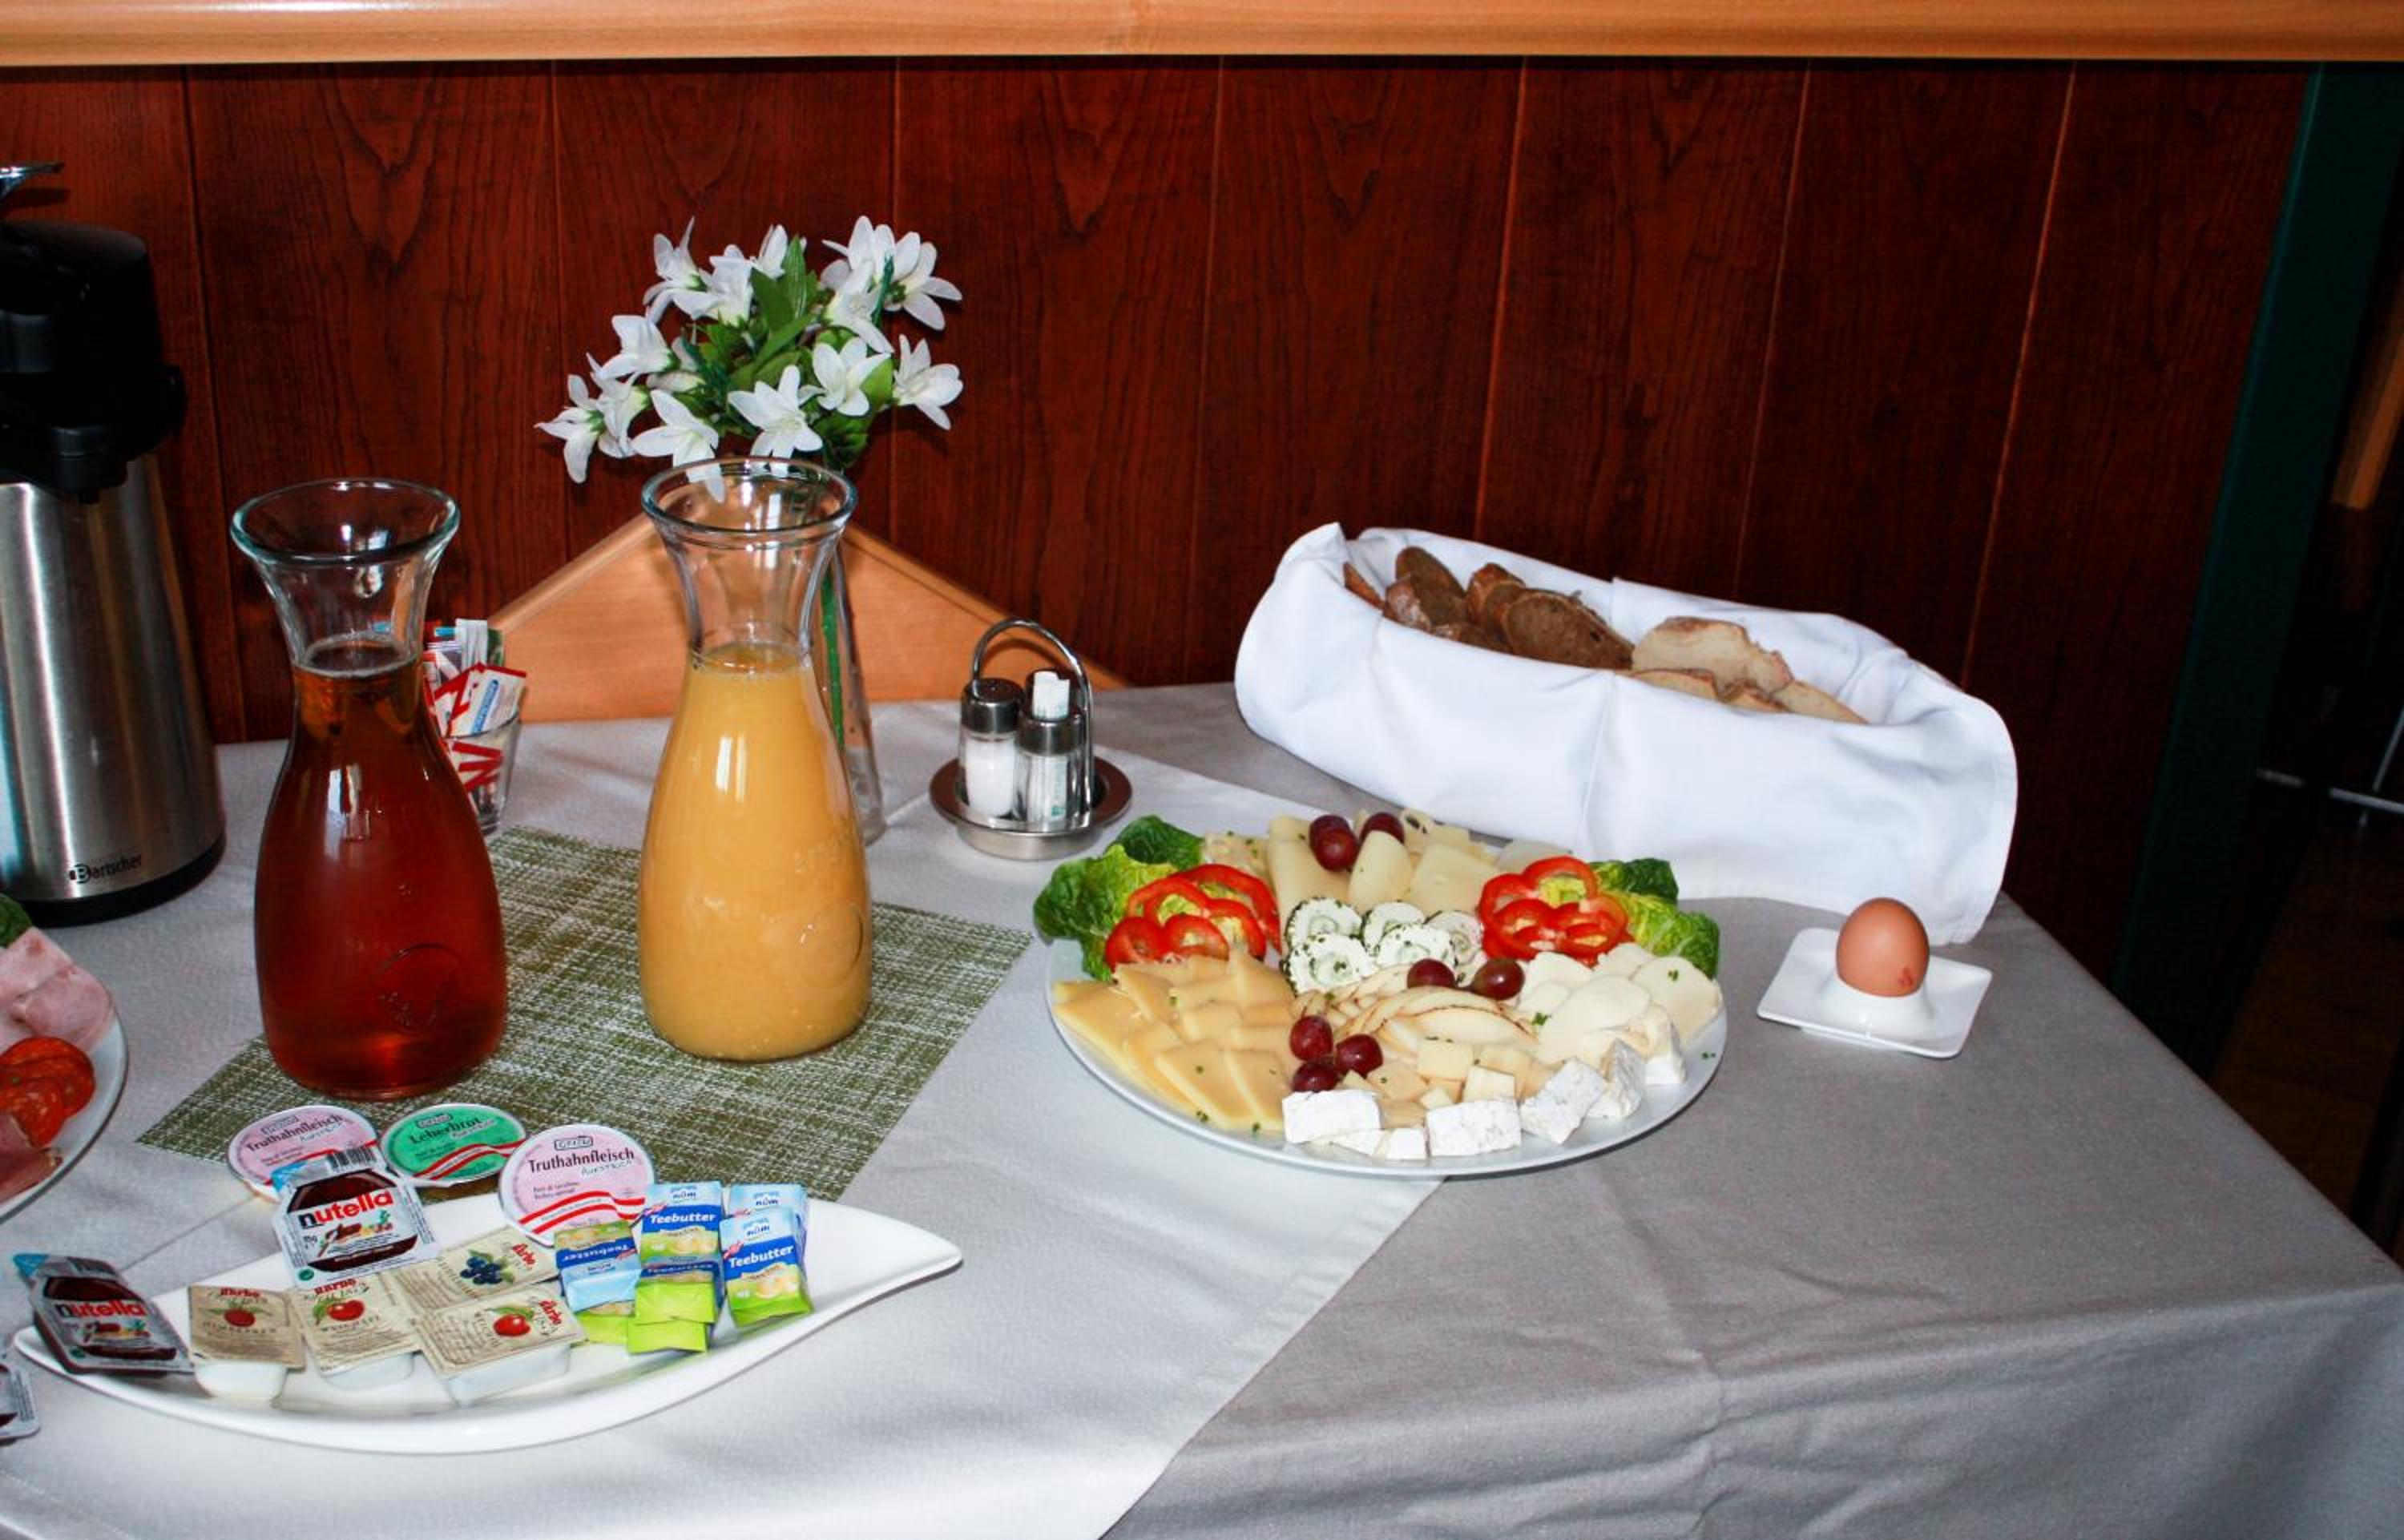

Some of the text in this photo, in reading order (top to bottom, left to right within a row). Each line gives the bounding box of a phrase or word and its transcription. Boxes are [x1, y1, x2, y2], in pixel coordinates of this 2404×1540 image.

[246, 1114, 343, 1152] Truthahnfleisch
[528, 1147, 635, 1174] Truthahnfleisch
[298, 1191, 394, 1229] nutella
[650, 1213, 716, 1224] Teebutter
[728, 1244, 794, 1268] Teebutter
[54, 1298, 147, 1318] nutella
